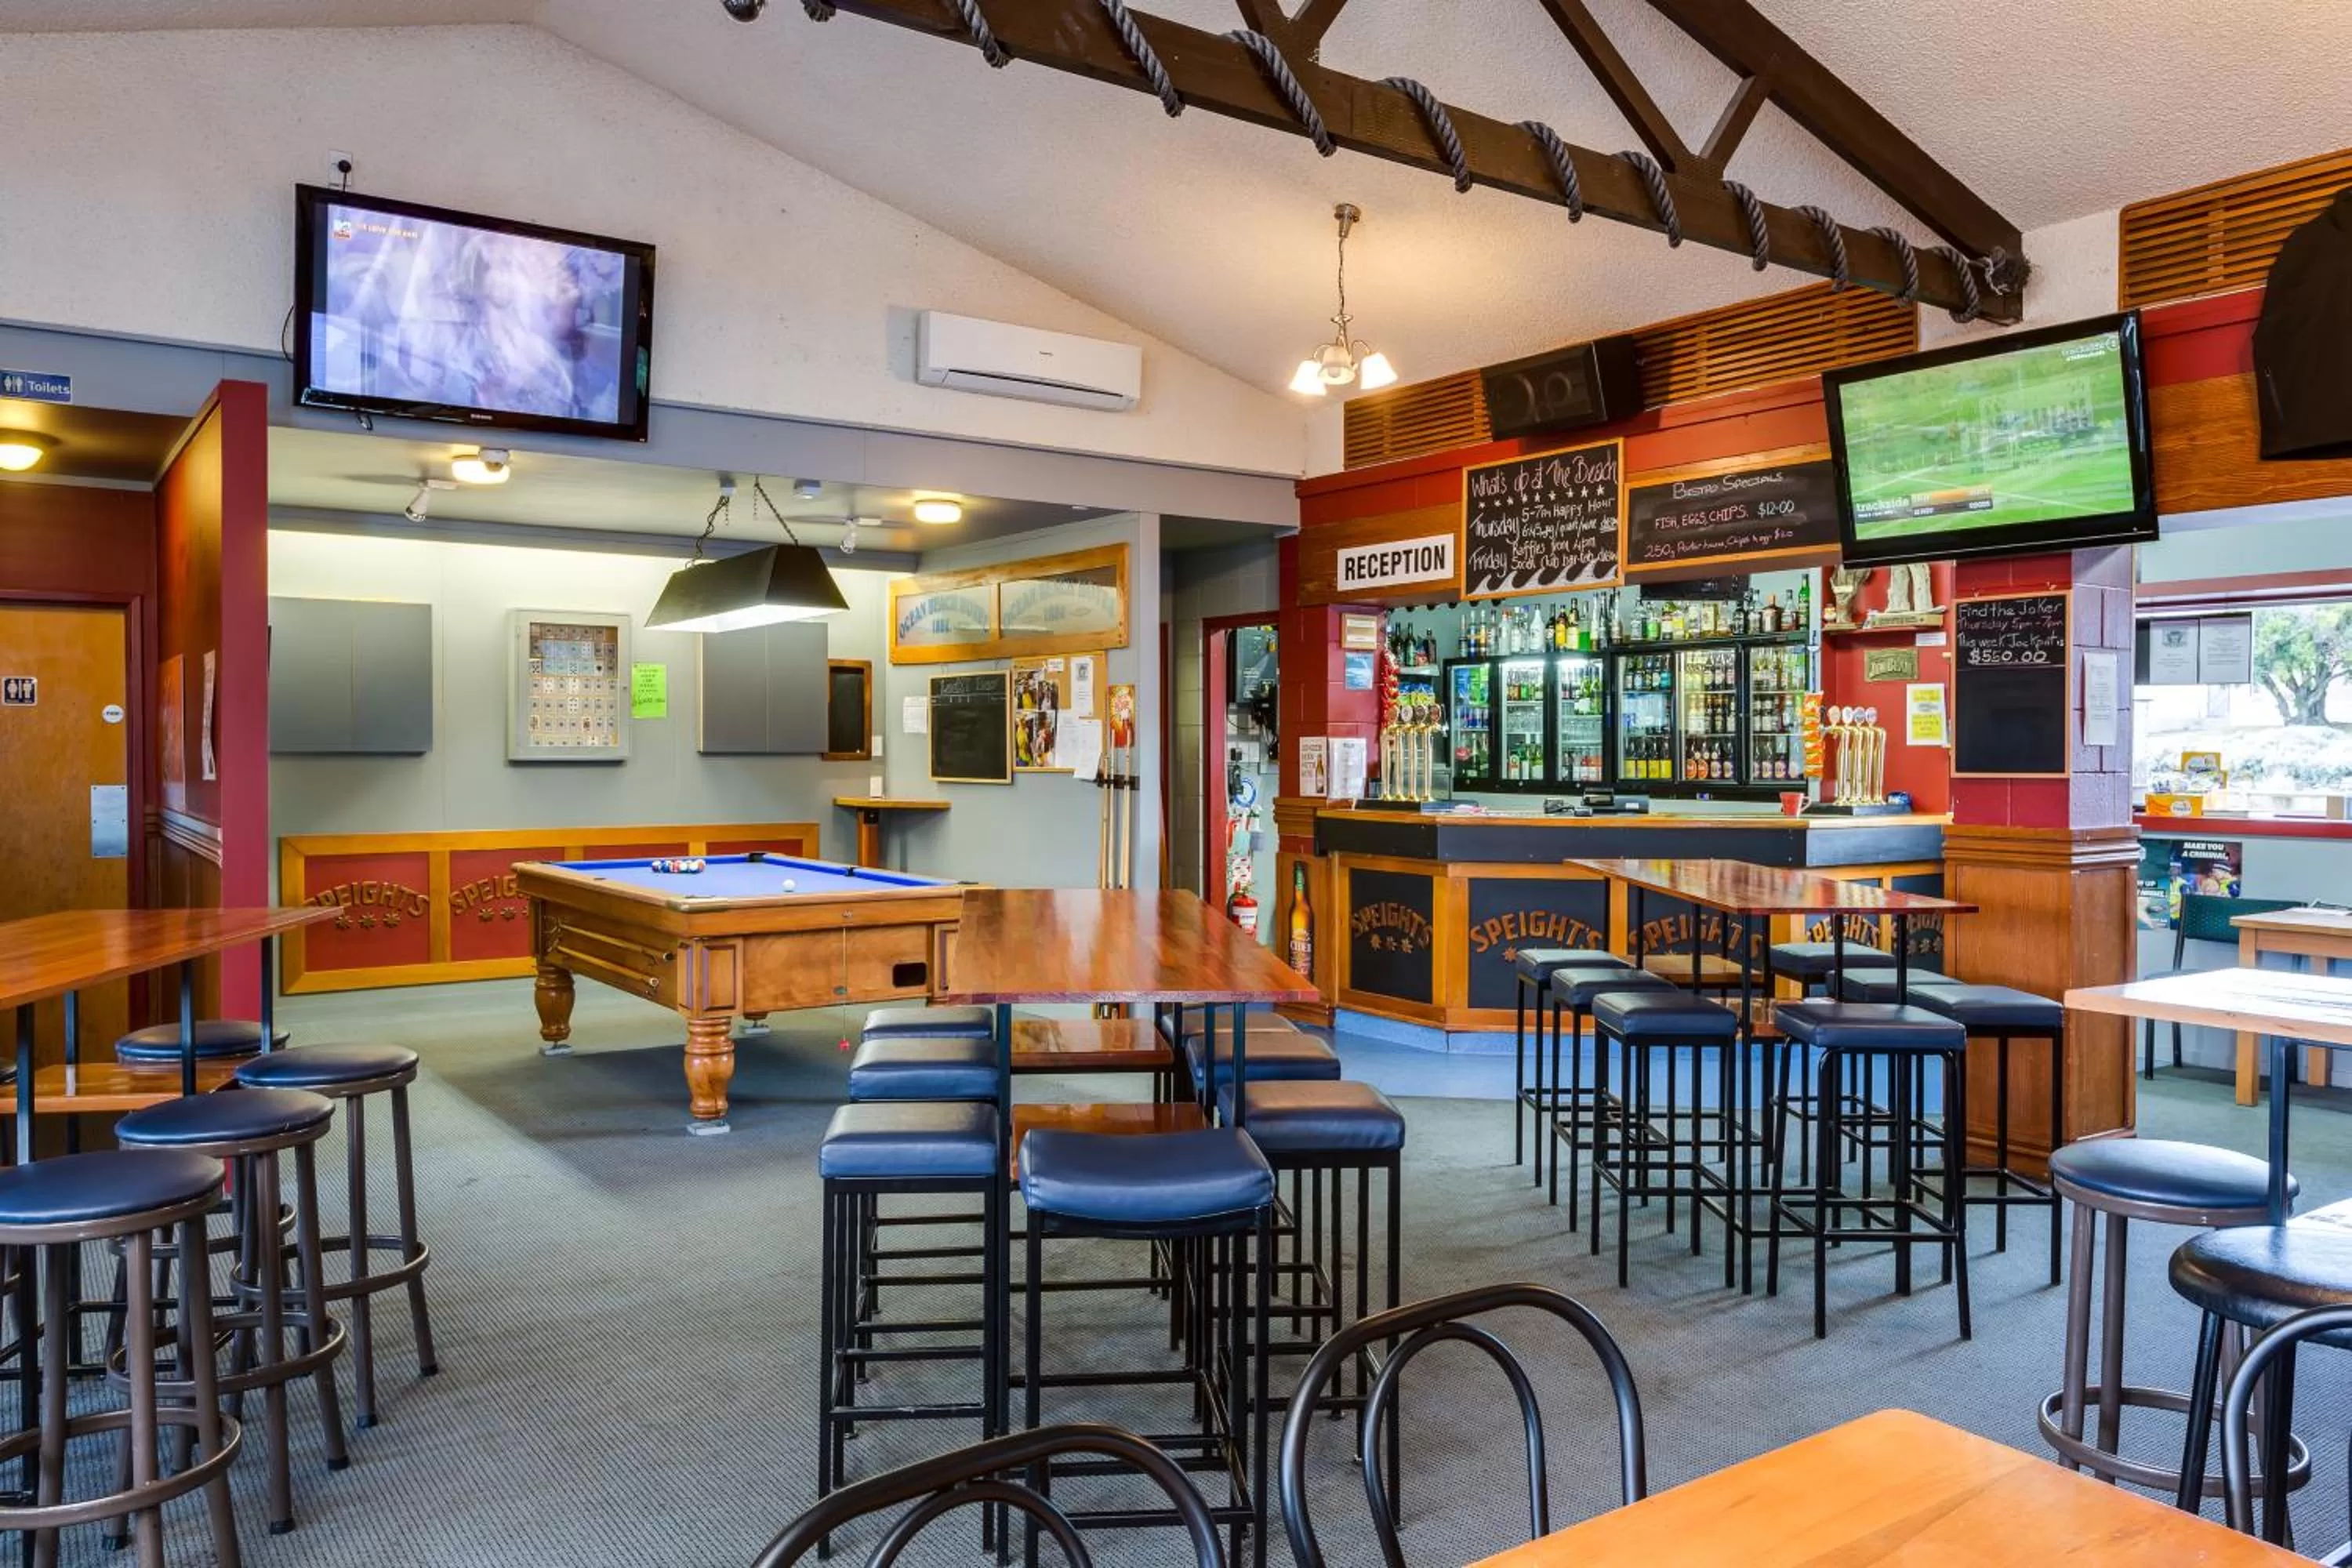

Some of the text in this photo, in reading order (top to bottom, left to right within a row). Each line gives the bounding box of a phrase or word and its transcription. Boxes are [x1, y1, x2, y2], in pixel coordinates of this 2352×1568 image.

[27, 380, 71, 394] Toilets
[1472, 470, 1507, 497] What's
[1531, 460, 1544, 489] at
[1573, 448, 1618, 485] Beach
[1553, 503, 1583, 520] Happy
[1345, 544, 1446, 581] RECEPTION
[1469, 546, 1507, 577] Friday
[1958, 603, 1988, 618] Find
[1990, 601, 2016, 617] the
[2183, 841, 2206, 850] MAKE
[448, 875, 518, 914] SPEIG
